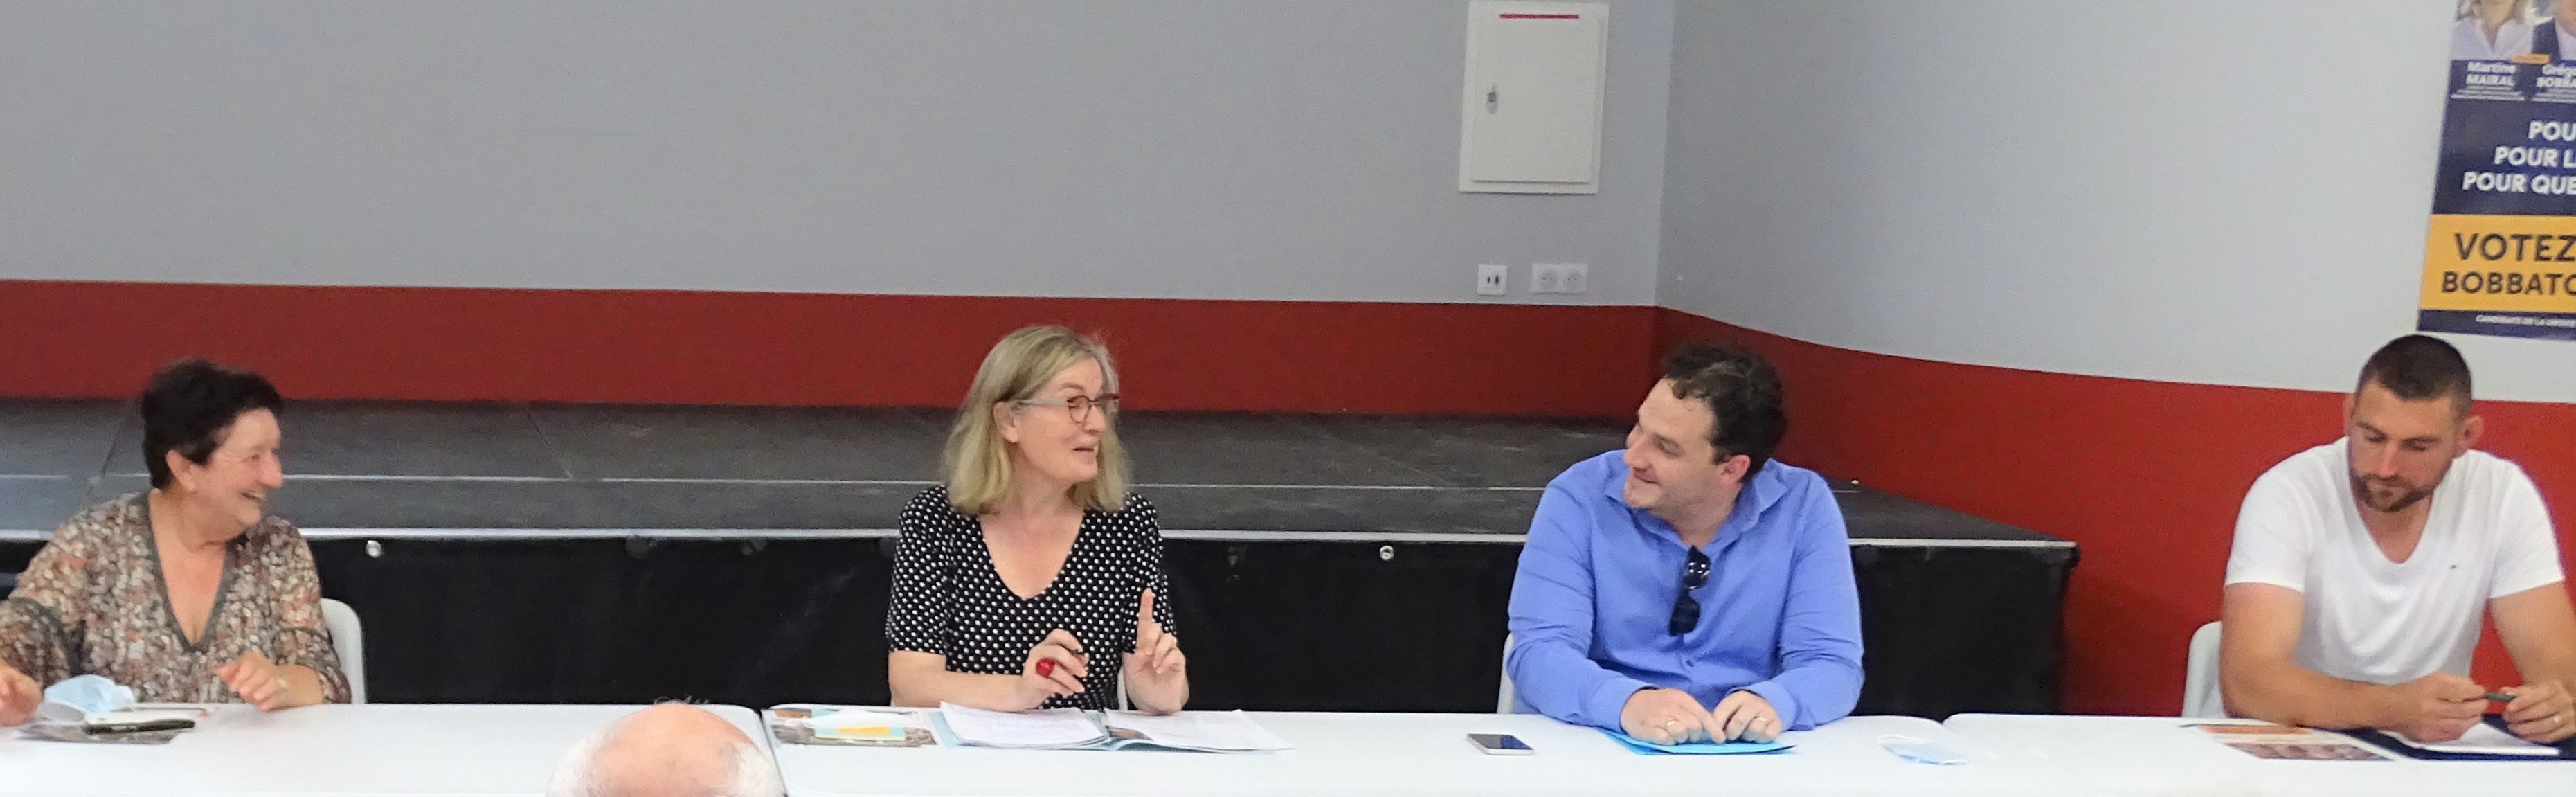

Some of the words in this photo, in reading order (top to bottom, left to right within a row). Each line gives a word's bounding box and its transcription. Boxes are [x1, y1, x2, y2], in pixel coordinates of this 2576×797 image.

[2494, 146, 2559, 168] POUR
[2462, 172, 2526, 192] POUR
[2455, 233, 2576, 261] VOTEZ
